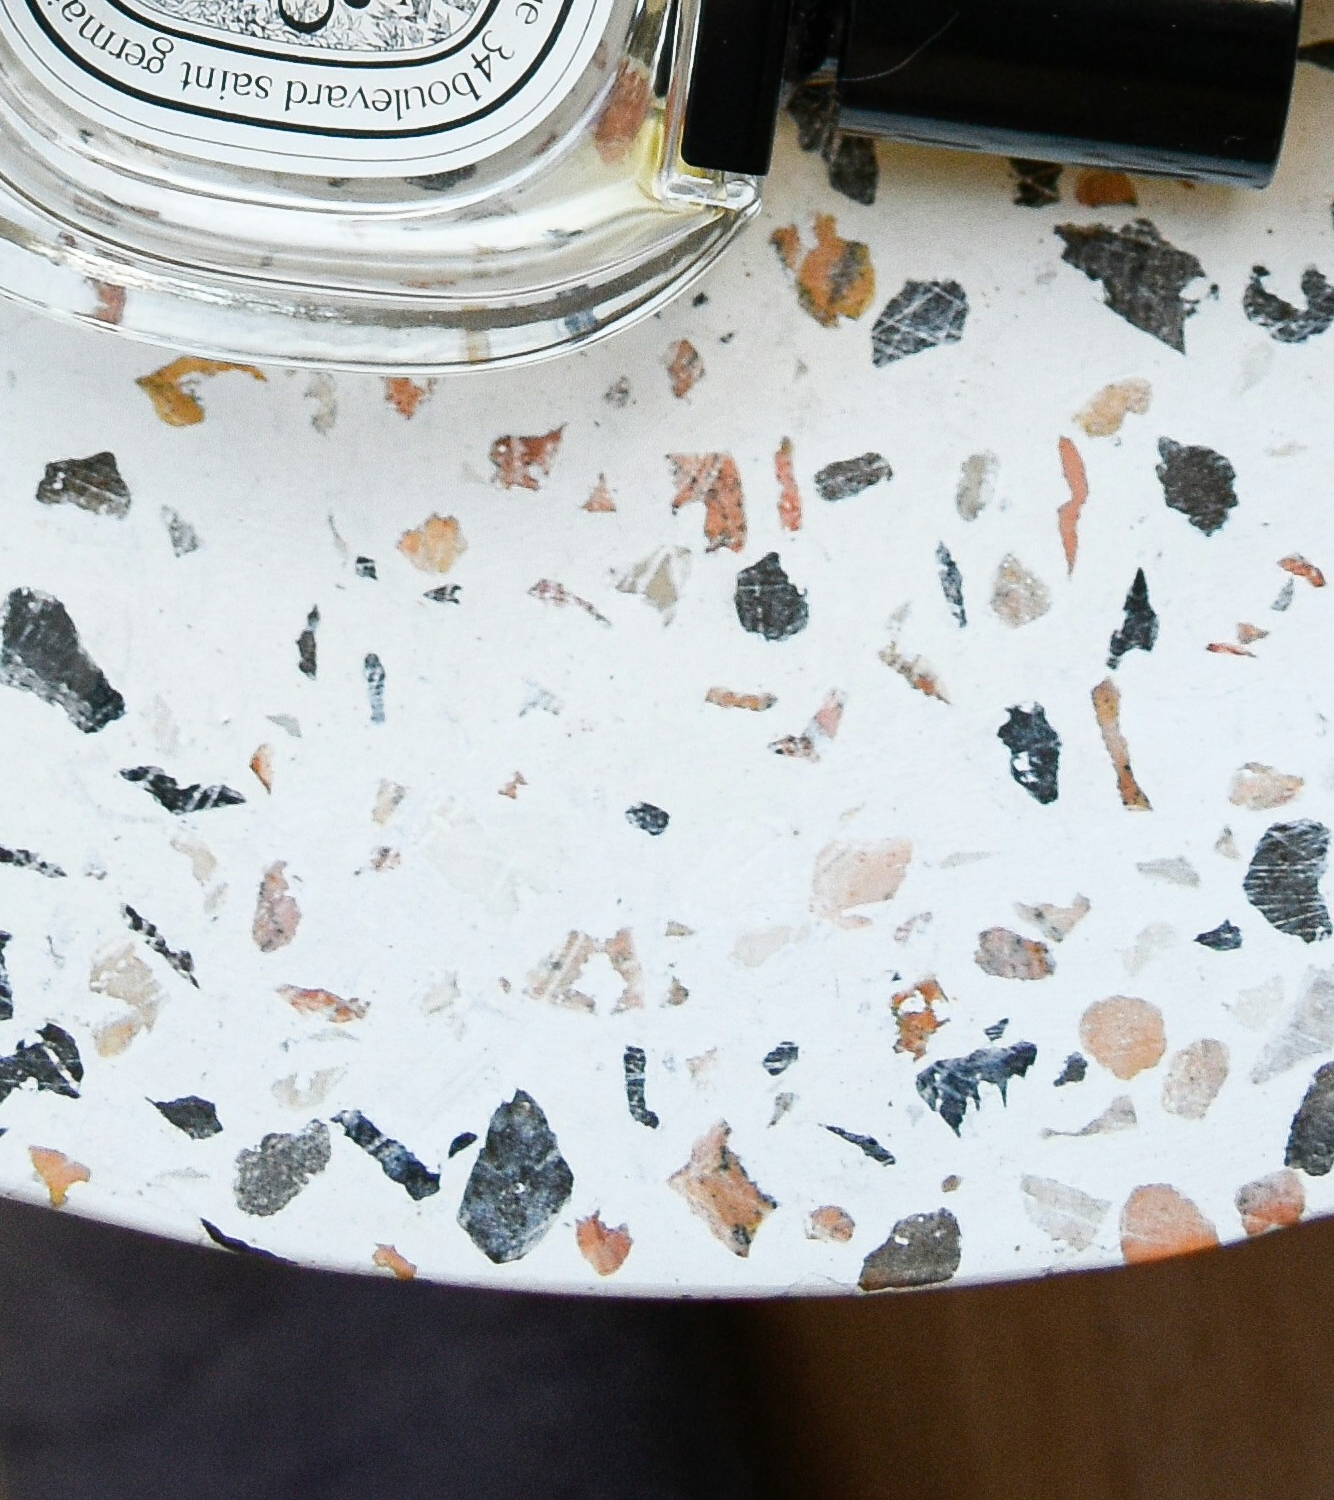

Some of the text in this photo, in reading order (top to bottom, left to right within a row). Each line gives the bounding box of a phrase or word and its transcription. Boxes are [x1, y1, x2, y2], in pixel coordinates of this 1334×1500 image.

[180, 59, 274, 100] saint
[468, 29, 516, 84] 34
[282, 68, 483, 123] boulevard
